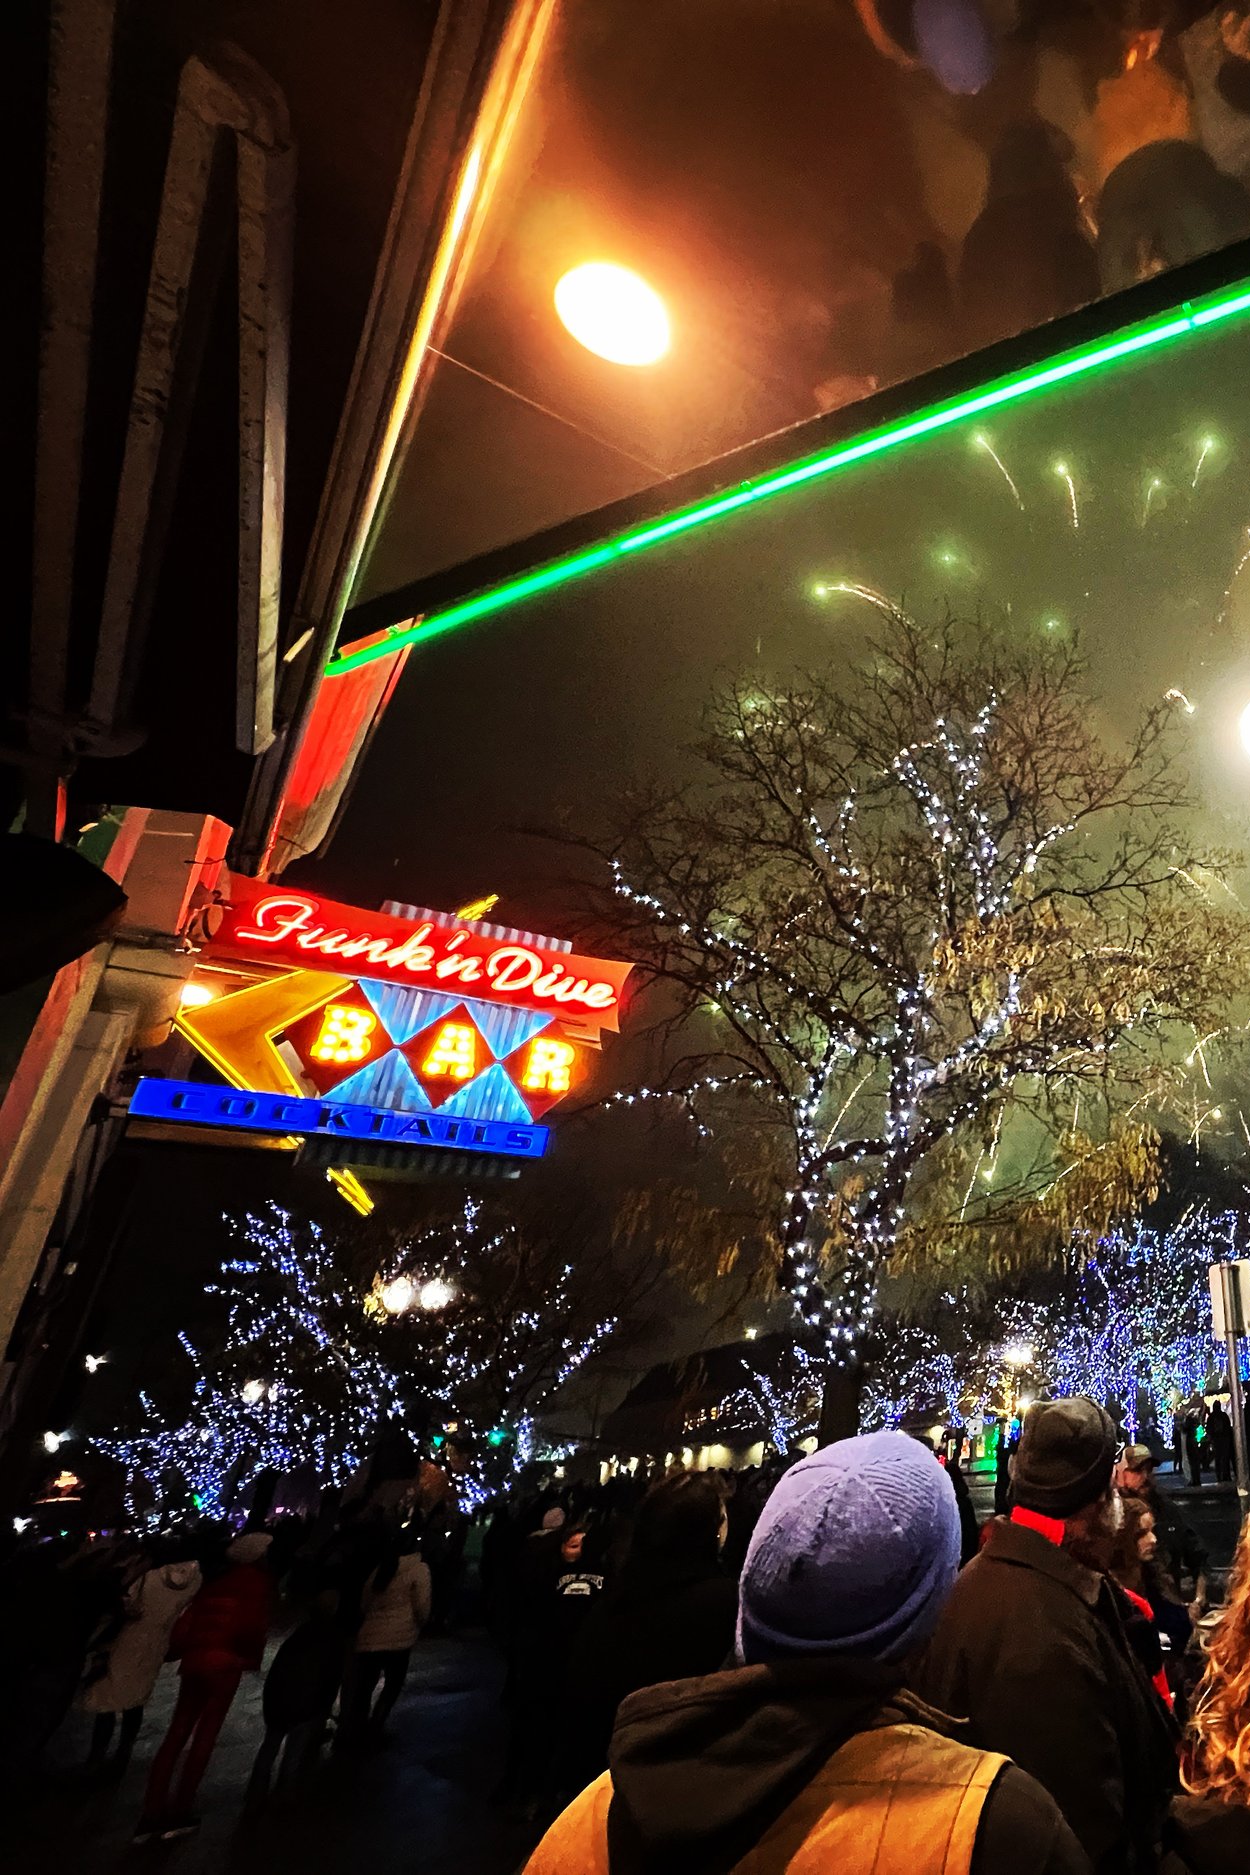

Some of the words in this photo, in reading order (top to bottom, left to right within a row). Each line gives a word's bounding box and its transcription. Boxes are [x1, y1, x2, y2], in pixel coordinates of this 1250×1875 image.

[236, 896, 484, 981] Funk'n
[487, 947, 618, 1007] Dive
[310, 1004, 575, 1092] BAR
[171, 1091, 532, 1149] COCKTAILS
